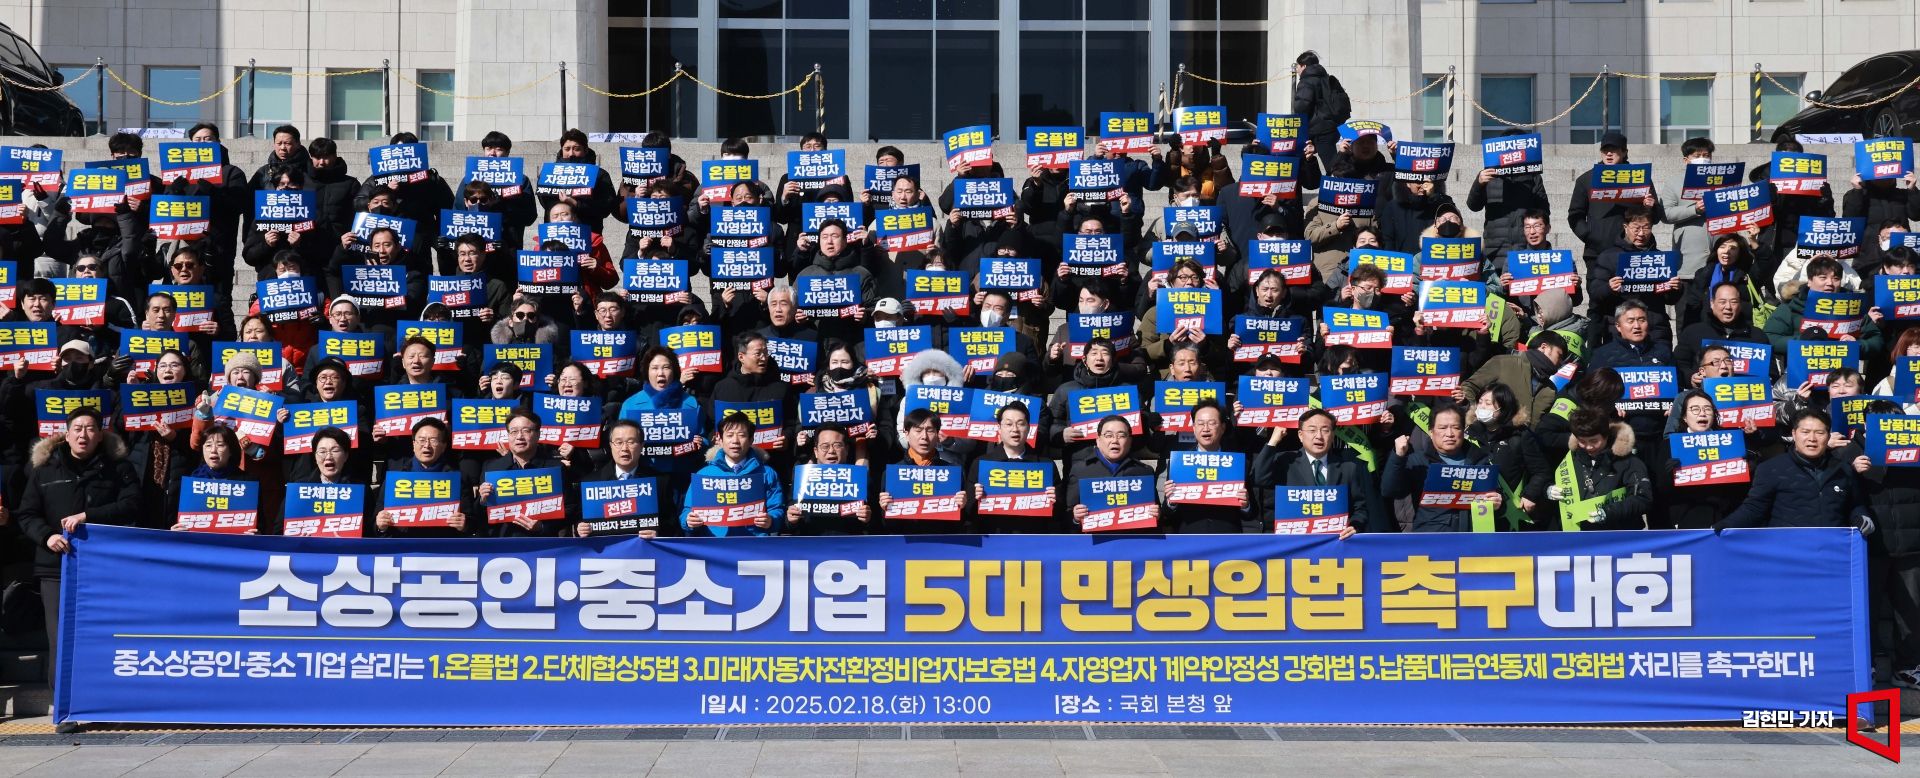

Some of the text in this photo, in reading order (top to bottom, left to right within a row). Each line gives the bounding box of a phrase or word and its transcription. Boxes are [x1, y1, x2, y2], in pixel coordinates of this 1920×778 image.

[1108, 118, 1148, 132] 온플법
[1266, 117, 1300, 127] 납품대금
[1271, 128, 1297, 138] 연동제
[949, 133, 983, 150] 온플법
[1273, 141, 1293, 150] 확대
[1486, 138, 1537, 153] 미래자동차
[1865, 141, 1904, 152] 납품대금
[168, 148, 213, 162] 온플법
[381, 146, 414, 160] 종속적
[1400, 146, 1451, 157] 미래자동차
[1503, 151, 1522, 164] 전환
[1871, 152, 1901, 162] 연동제
[377, 158, 421, 172] 자영업자
[800, 153, 834, 165] 종속적
[1416, 160, 1435, 170] 전환
[794, 164, 839, 176] 자영업자
[1250, 161, 1292, 176] 온플법
[1779, 158, 1821, 174] 온플법
[1876, 164, 1898, 174] 확대
[709, 166, 751, 180] 온플법
[73, 175, 116, 190] 온플법
[966, 181, 1000, 193] 종속적
[1323, 180, 1374, 193] 미래자동차
[266, 194, 301, 205] 종속적
[961, 193, 1007, 205] 자영업자
[1338, 195, 1357, 204] 전환
[156, 201, 201, 217] 온플법
[1730, 200, 1748, 211] 5법
[261, 206, 309, 218] 자영업자
[722, 210, 757, 222] 종속적
[883, 213, 926, 230] 온플법
[717, 222, 763, 234] 자영업자
[1075, 237, 1110, 249] 종속적
[1259, 243, 1301, 253] 단체협상
[723, 251, 759, 263] 종속적
[1069, 250, 1117, 262] 자영업자
[1430, 244, 1474, 259] 온플법
[520, 255, 574, 267] 미래자동차
[1518, 253, 1561, 263] 단체협상
[536, 269, 557, 281] 전환
[636, 263, 673, 275] 종속적
[718, 264, 767, 276] 자영업자
[1532, 264, 1549, 274] 5법
[630, 276, 680, 288] 자영업자
[753, 278, 771, 289] 보장!
[915, 277, 961, 292] 온플법
[1168, 292, 1210, 303] 납품대금
[1428, 287, 1477, 303] 온플법
[386, 296, 404, 307] 보장!
[1816, 299, 1861, 315] 온플법
[1174, 303, 1205, 314] 연동제
[1246, 319, 1291, 331] 단체협상
[1333, 313, 1381, 327] 온플법
[0, 329, 48, 345] 온플법
[581, 333, 626, 344] 단체협상
[667, 332, 713, 349] 온플법
[876, 329, 920, 341] 단체협상
[961, 331, 1004, 342] 납품대금
[1326, 332, 1390, 344] 즉각 제정!
[966, 344, 999, 355] 연동제
[1801, 345, 1848, 356] 납품대금
[1404, 350, 1450, 362] 단체협상
[970, 359, 995, 371] 확대
[1417, 363, 1436, 374] 5법
[1807, 358, 1841, 369] 연동제
[1251, 379, 1298, 392] 단체협상
[1332, 376, 1378, 390] 단체협상
[1391, 376, 1460, 392] 당장 도입!
[917, 388, 963, 401] 단체협상
[1347, 390, 1365, 402] 5법
[1633, 385, 1655, 397] 전환
[1715, 384, 1765, 401] 온플법
[132, 389, 186, 406] 온플법
[384, 391, 436, 409] 온플법
[814, 394, 855, 409] 종속적
[1079, 393, 1130, 413] 온플법
[1264, 394, 1283, 405] 5법
[223, 393, 273, 418] 온플법
[544, 397, 591, 411] 단체협상
[930, 402, 949, 413] 5법
[294, 407, 347, 427] 온플법
[556, 412, 575, 424] 5법
[808, 407, 863, 423] 자영업자
[563, 426, 600, 441] 도입!
[1682, 433, 1732, 448] 단체협상
[1699, 448, 1719, 460] 5법
[1888, 450, 1917, 461] 확대
[1183, 454, 1233, 467] 단체협상
[899, 468, 949, 481] 단체협상
[1197, 468, 1217, 480] 5법
[1441, 467, 1489, 479] 단체협상
[1710, 460, 1746, 478] 도입!
[702, 478, 752, 490] 단체협상
[989, 469, 1043, 488] 온플법
[193, 481, 245, 496] 단체협상
[394, 480, 450, 498] 온플법
[496, 475, 552, 496] 온플법
[586, 483, 652, 500] 미래자동차
[913, 483, 933, 495] 5법
[1092, 479, 1142, 493] 단체협상
[1452, 480, 1473, 491] 5법
[299, 487, 352, 500] 단체협상
[717, 492, 737, 504] 5법
[1107, 493, 1127, 505] 5법
[1288, 489, 1337, 501] 단체협상
[207, 497, 228, 509] 5법
[314, 501, 335, 513] 5법
[489, 497, 562, 520] 즉각 제정!
[608, 500, 632, 513] 전환
[813, 501, 862, 516] 안정성 보장!
[1302, 503, 1322, 515] 5법
[639, 518, 658, 527] 절실!
[1083, 511, 1115, 529] 당장
[239, 553, 1691, 631] 소상공인·중소기업 5대 민생입법 촉구대회
[113, 650, 1814, 683] 중소상공인·중소기업 살리는 1.온플법 2.단체협상5법 3.미래자동차전환정비업자보호법 4.자영업자 계약안정성 강화법 5.납품대금연동제 강화법 처리를 촉구한다!
[708, 695, 746, 714] 일시
[767, 696, 925, 714] 2025.02.18.(화)
[933, 696, 990, 714] 13:00
[1062, 696, 1100, 714] 장소
[1120, 695, 1158, 713] 국회
[1167, 695, 1205, 713] 본청
[1214, 695, 1232, 712] 앞
